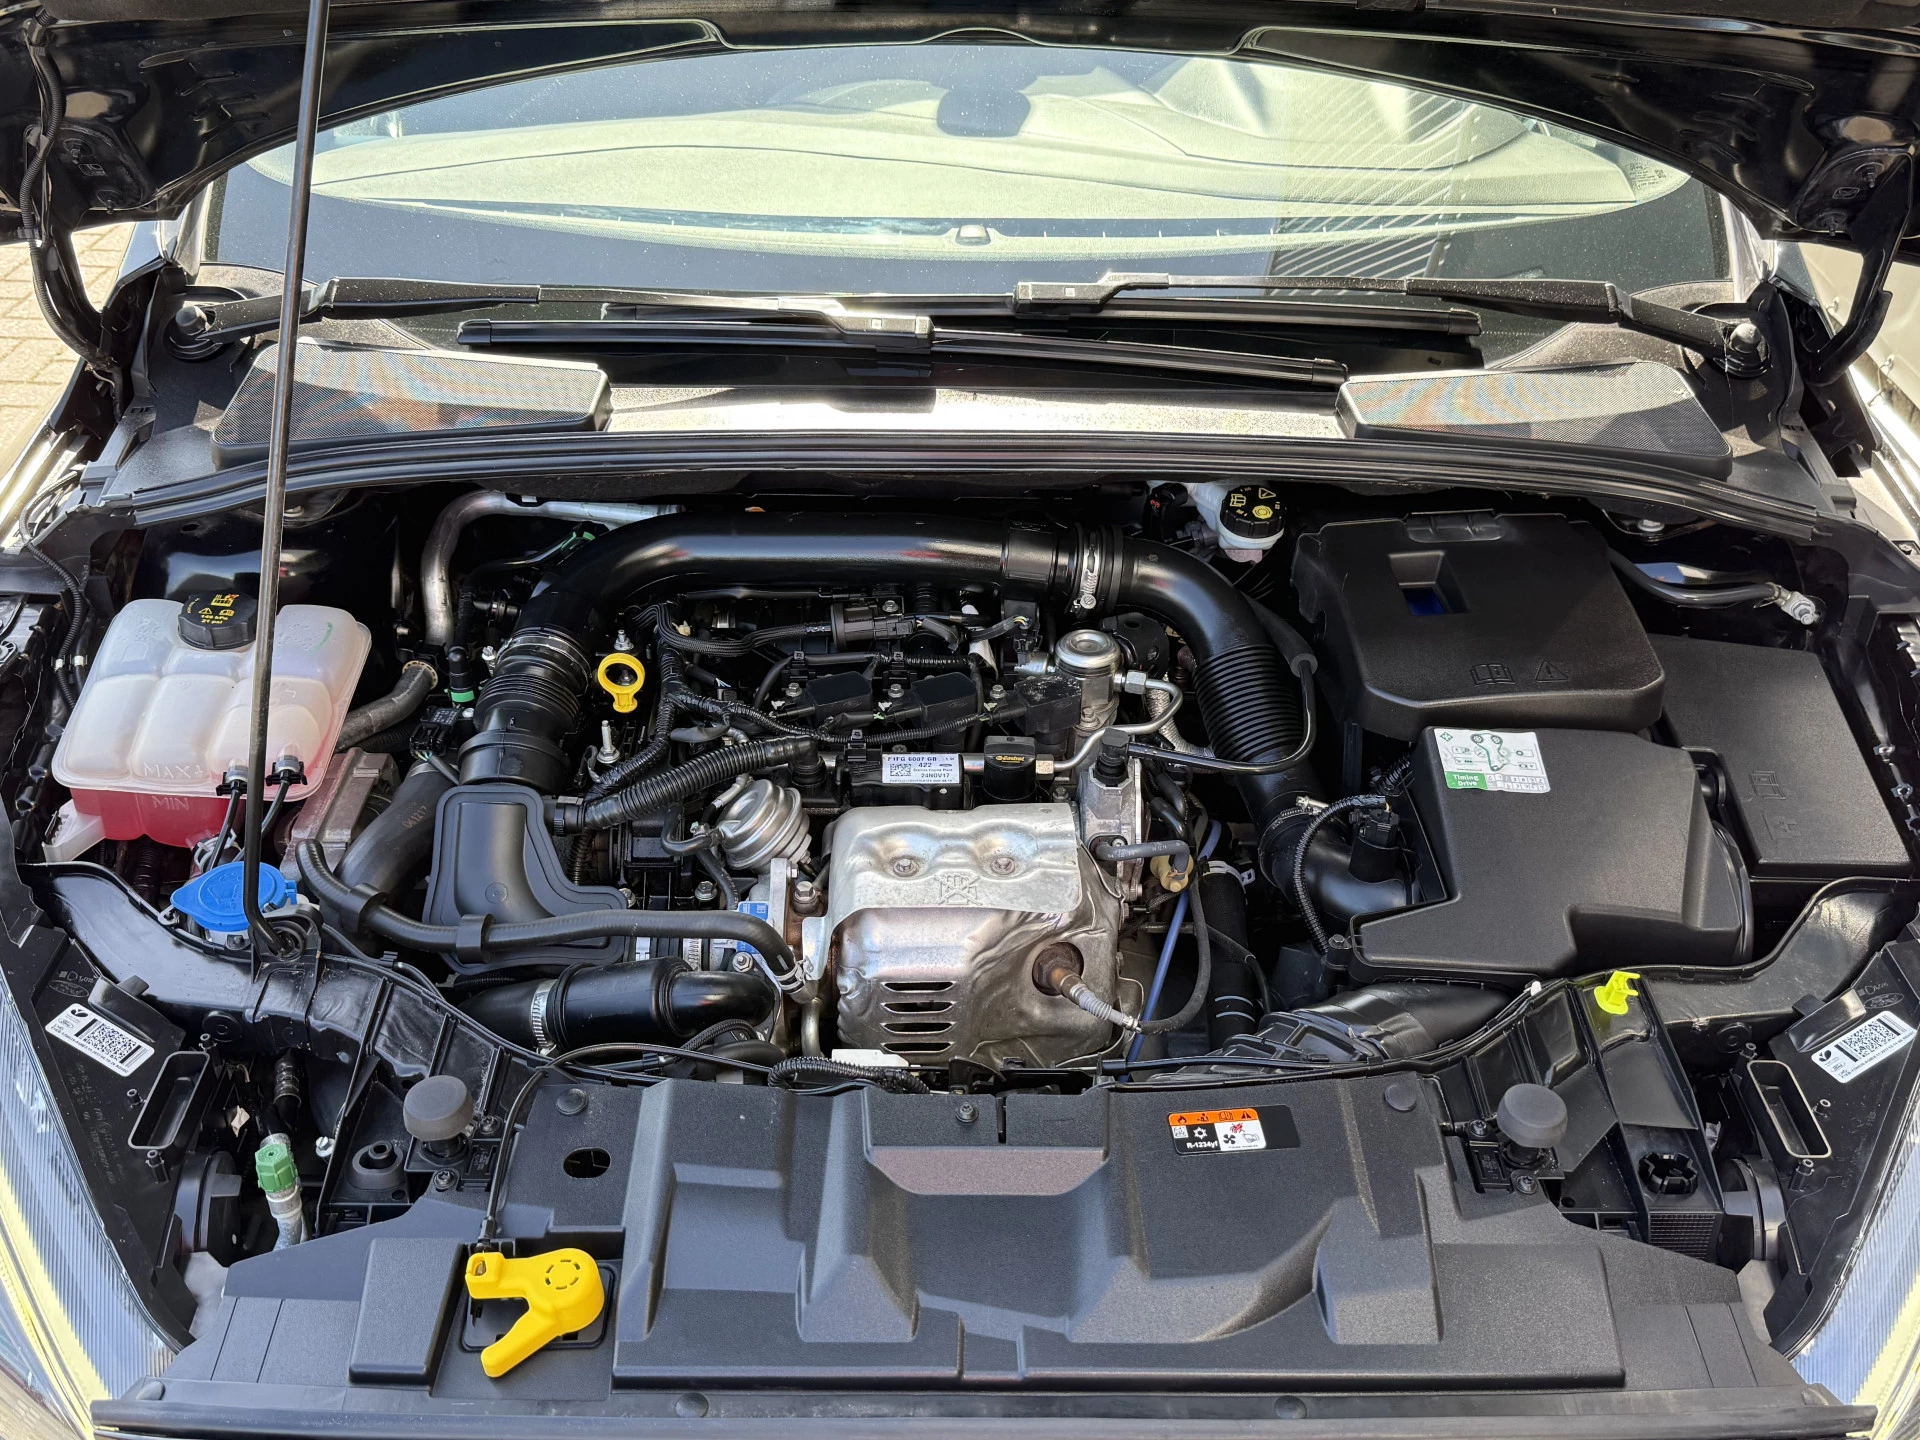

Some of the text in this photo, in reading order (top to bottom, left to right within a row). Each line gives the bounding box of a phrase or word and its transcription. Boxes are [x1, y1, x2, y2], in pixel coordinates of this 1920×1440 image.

[143, 761, 191, 779] MAX
[151, 795, 190, 810] MIN
[1186, 1140, 1218, 1149] R-1234yf
